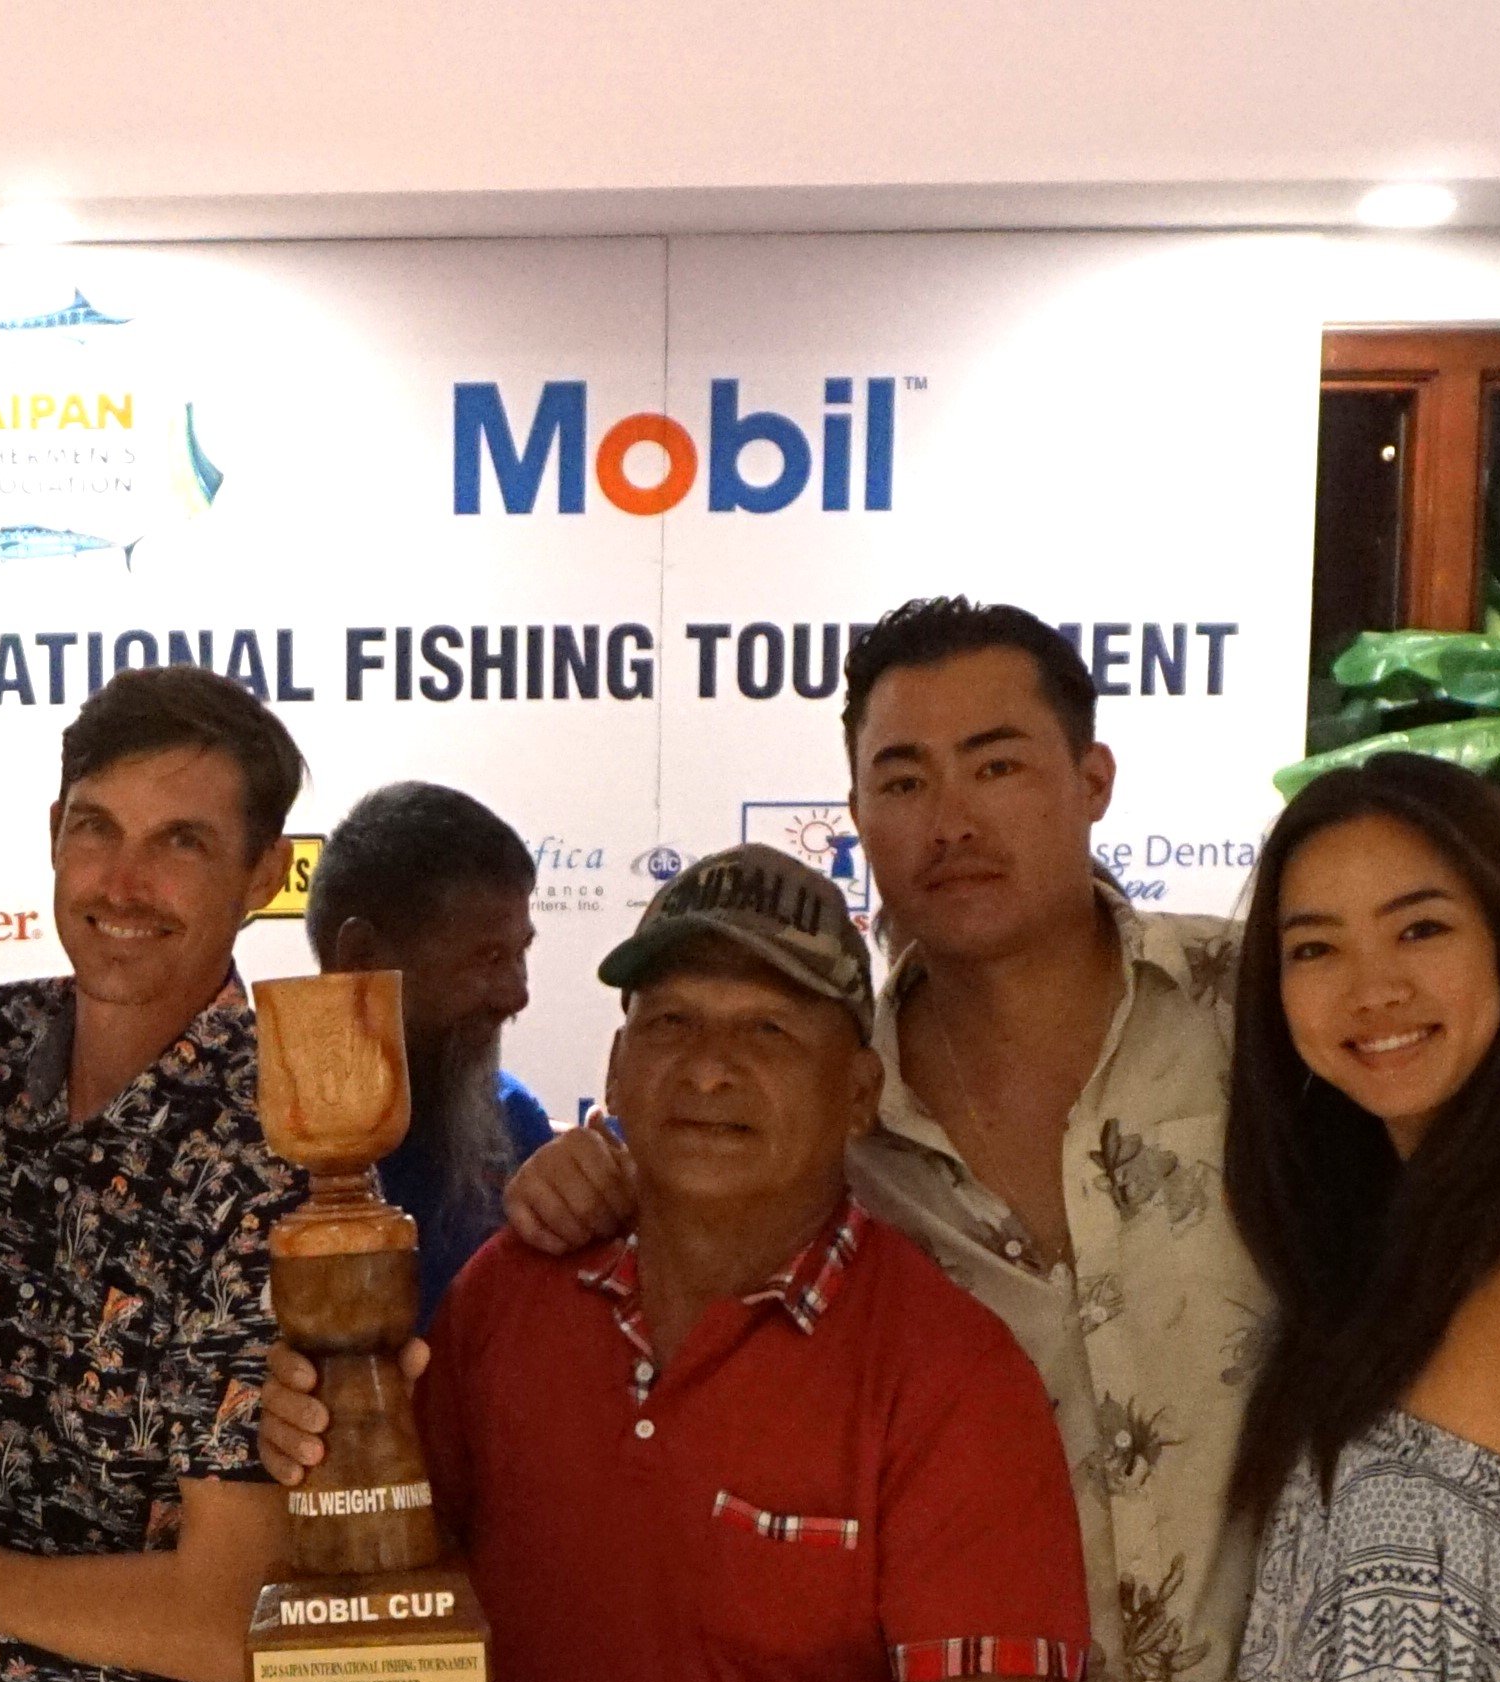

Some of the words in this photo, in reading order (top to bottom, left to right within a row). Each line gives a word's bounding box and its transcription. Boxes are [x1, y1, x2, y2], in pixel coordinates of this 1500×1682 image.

[451, 378, 897, 516] Mobil
[346, 623, 654, 701] FISHING
[1146, 835, 1264, 868] Denta
[318, 1487, 387, 1516] WEIGHT
[279, 1597, 379, 1626] MOBIL
[388, 1591, 455, 1620] CUP
[310, 1659, 379, 1677] INTERNATIONAL
[417, 1656, 478, 1672] TOURNAMENT
